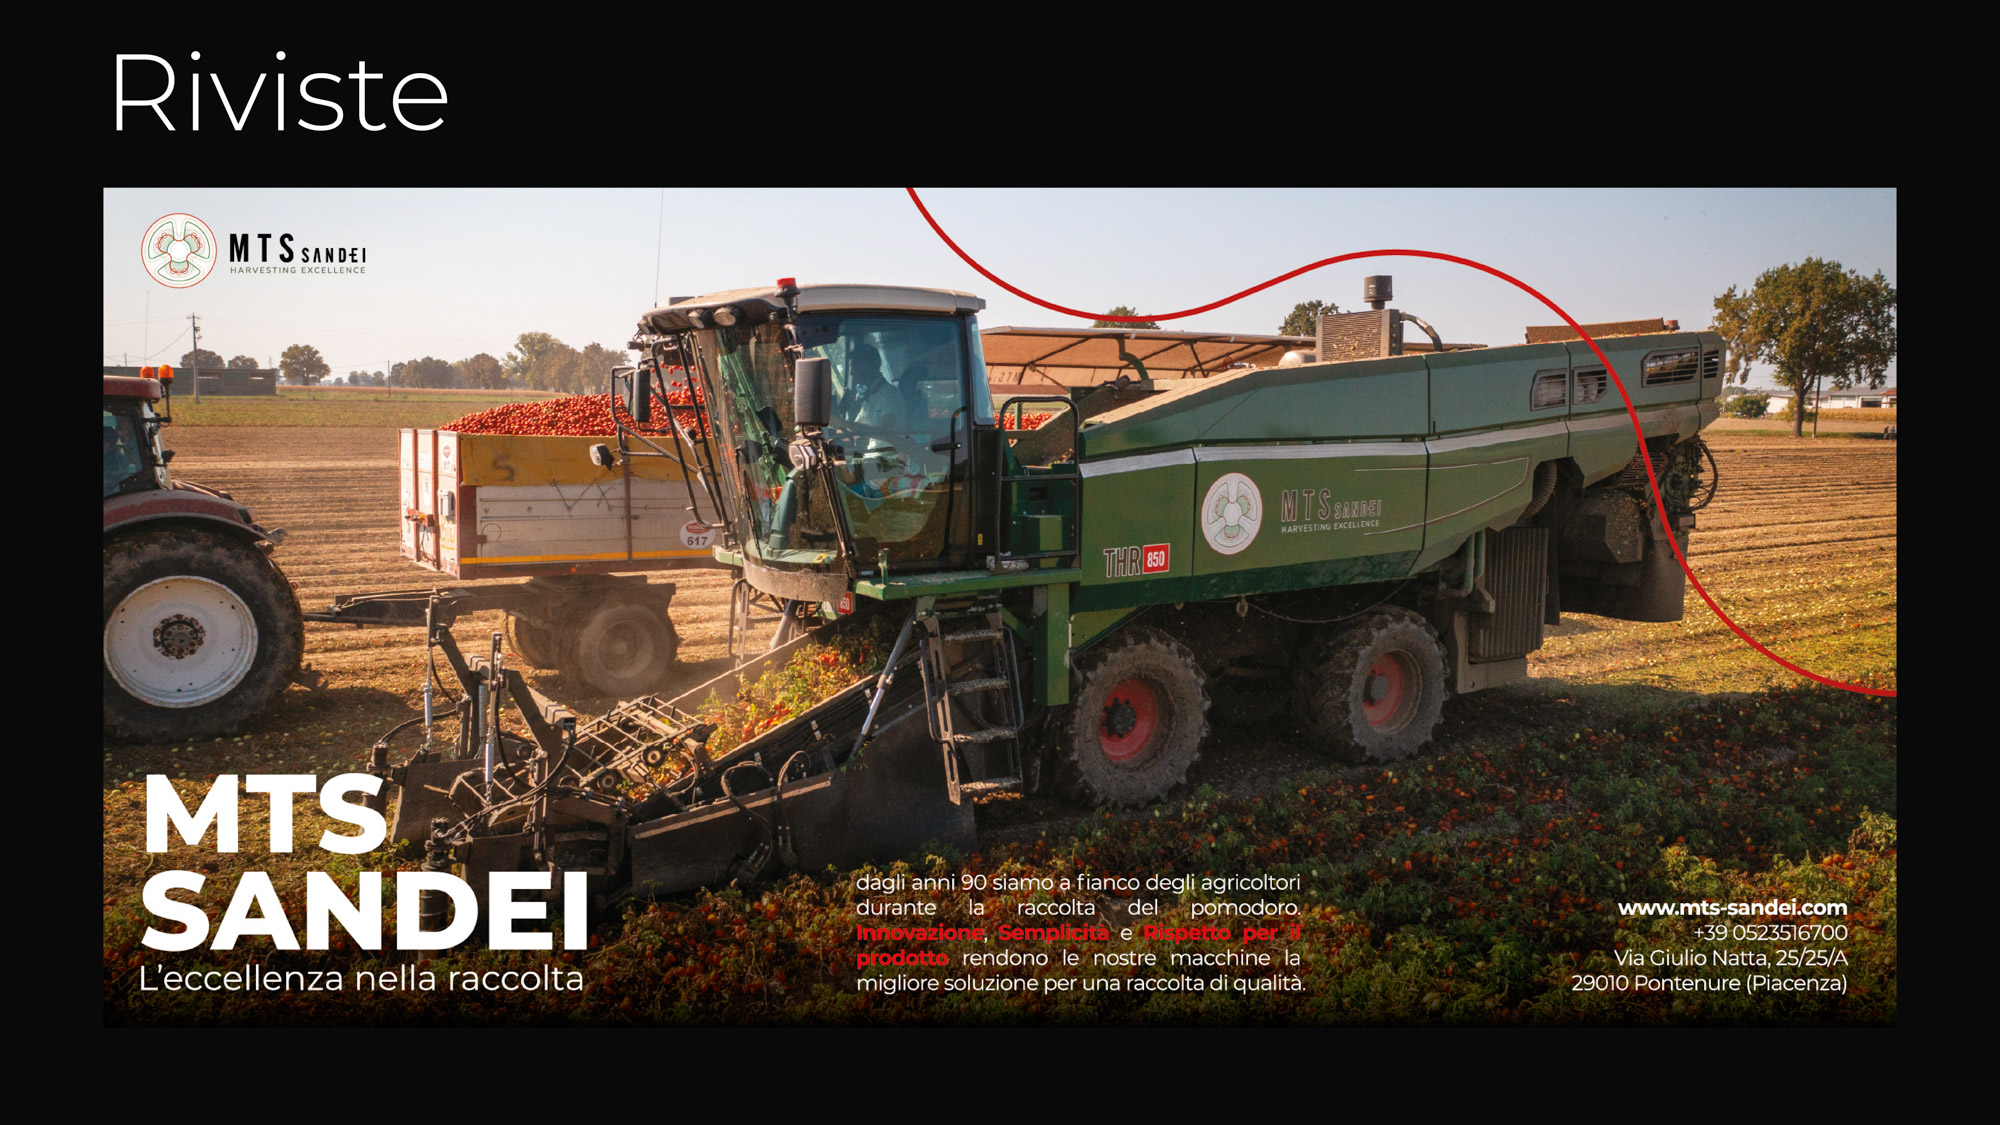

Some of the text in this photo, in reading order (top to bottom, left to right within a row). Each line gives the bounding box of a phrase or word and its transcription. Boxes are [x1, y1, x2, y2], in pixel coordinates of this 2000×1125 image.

[1281, 488, 1382, 522] MTS SANDEI
[1281, 520, 1380, 533] HARVESTING EXCELLENCE
[687, 536, 708, 546] 617
[1103, 546, 1165, 578] THR 850
